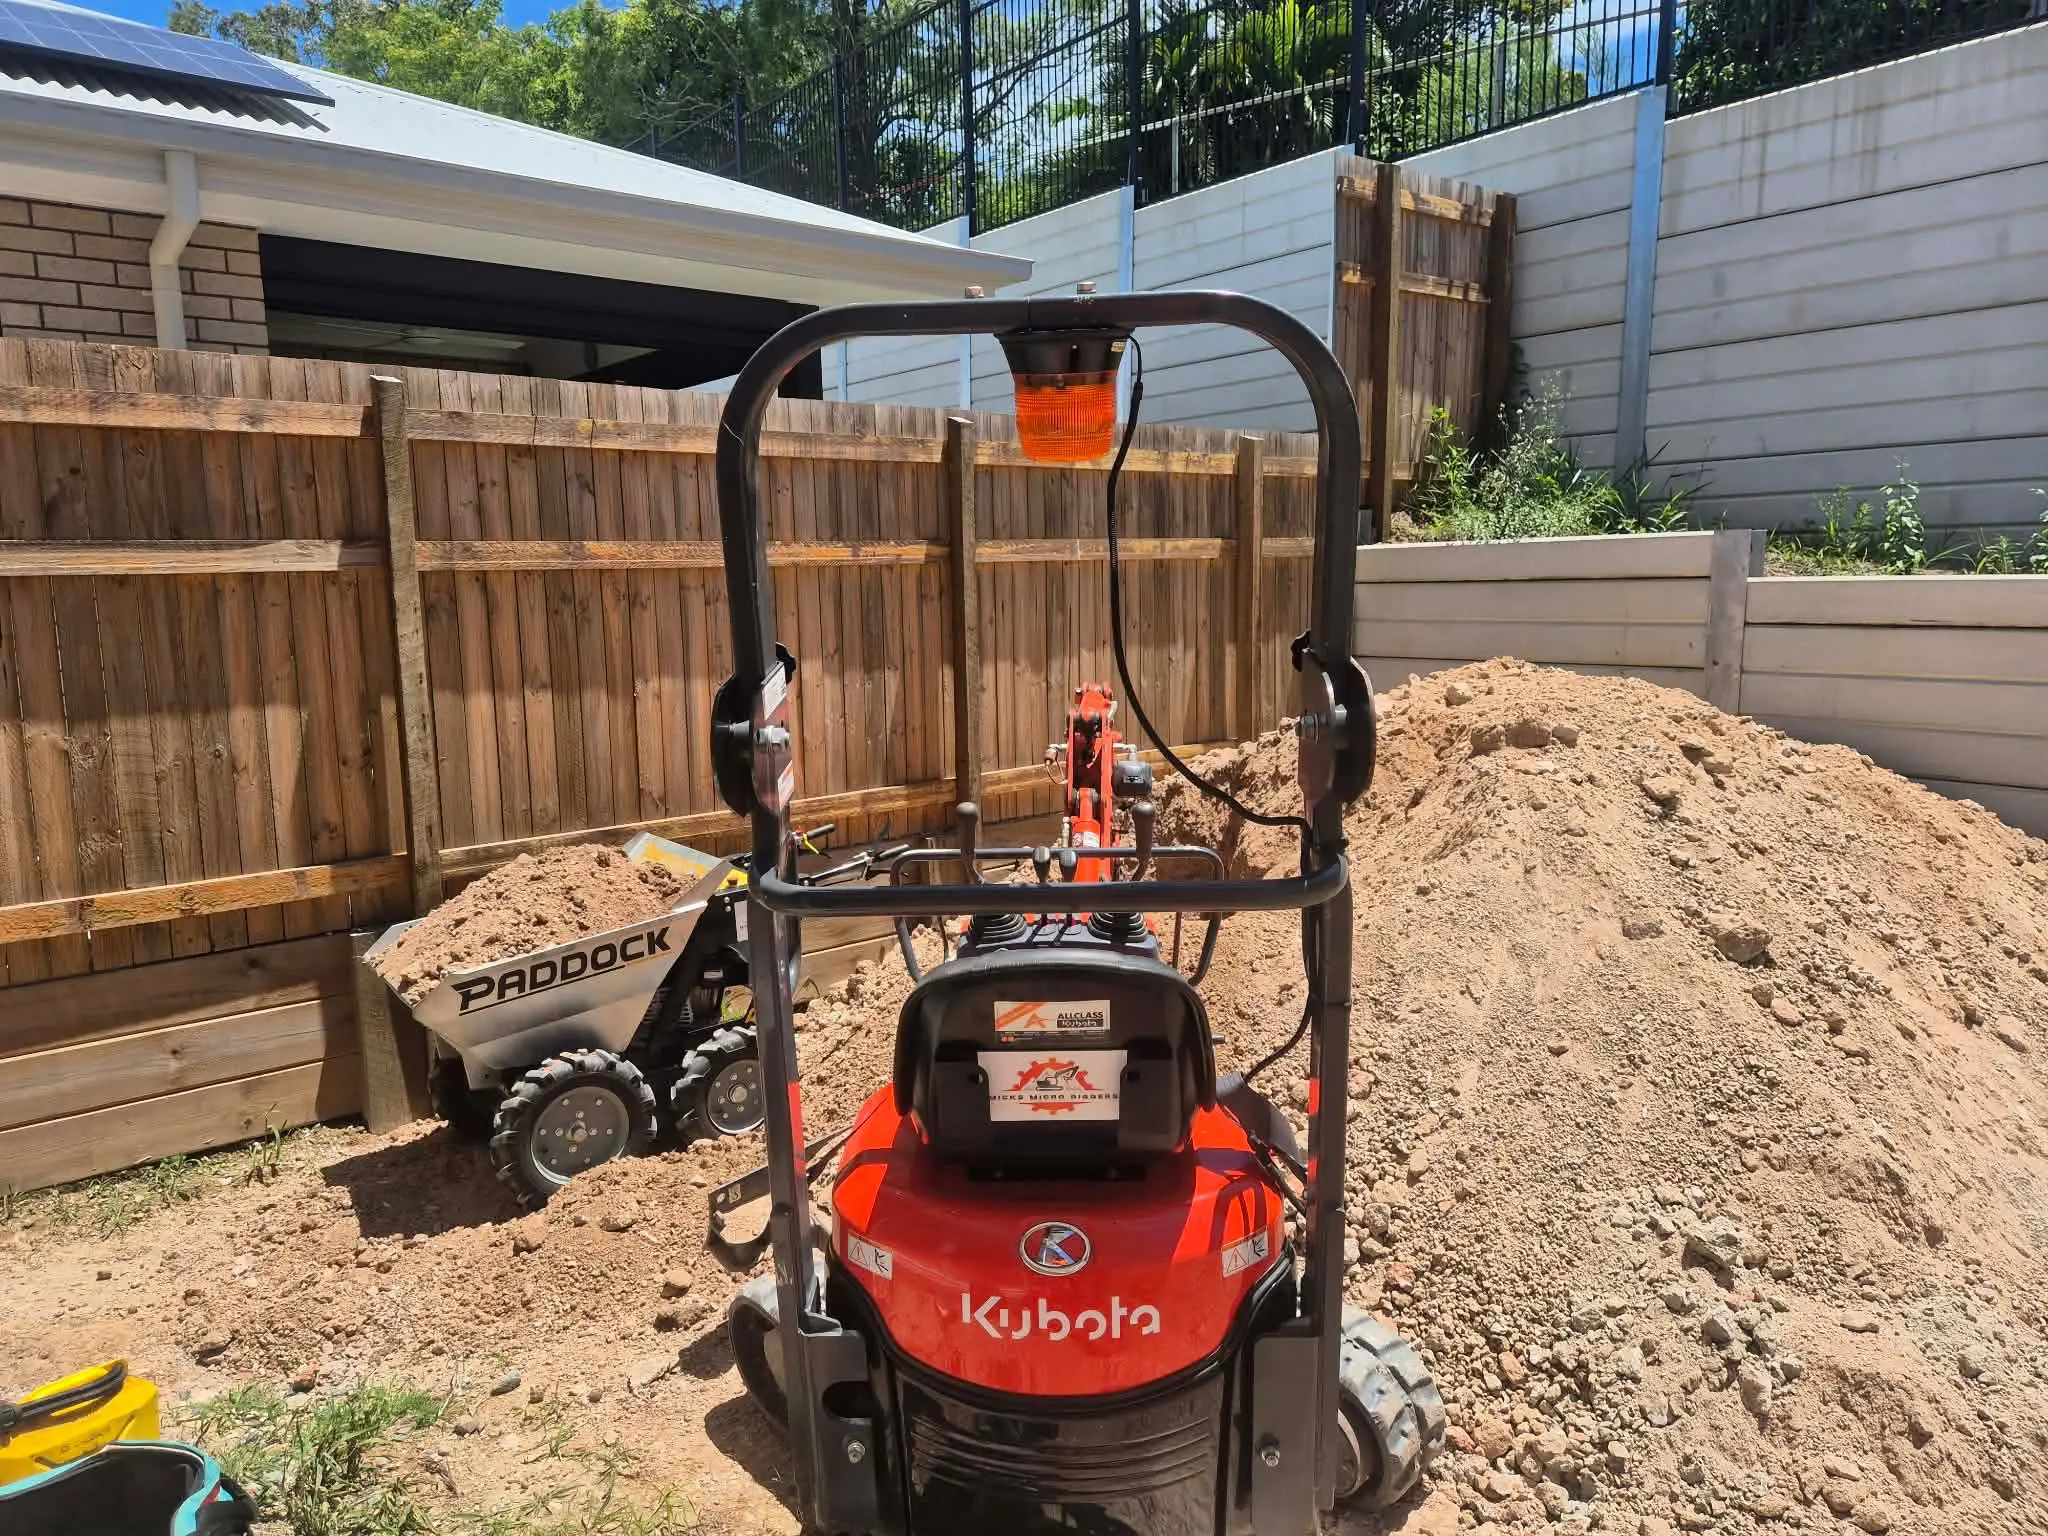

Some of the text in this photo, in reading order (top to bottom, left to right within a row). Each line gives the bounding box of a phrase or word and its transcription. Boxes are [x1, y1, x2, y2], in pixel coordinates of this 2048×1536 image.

[451, 926, 672, 1011] PADDOCK
[1058, 1011, 1103, 1020] ALLCLASS
[961, 1292, 1161, 1341] Kubota
